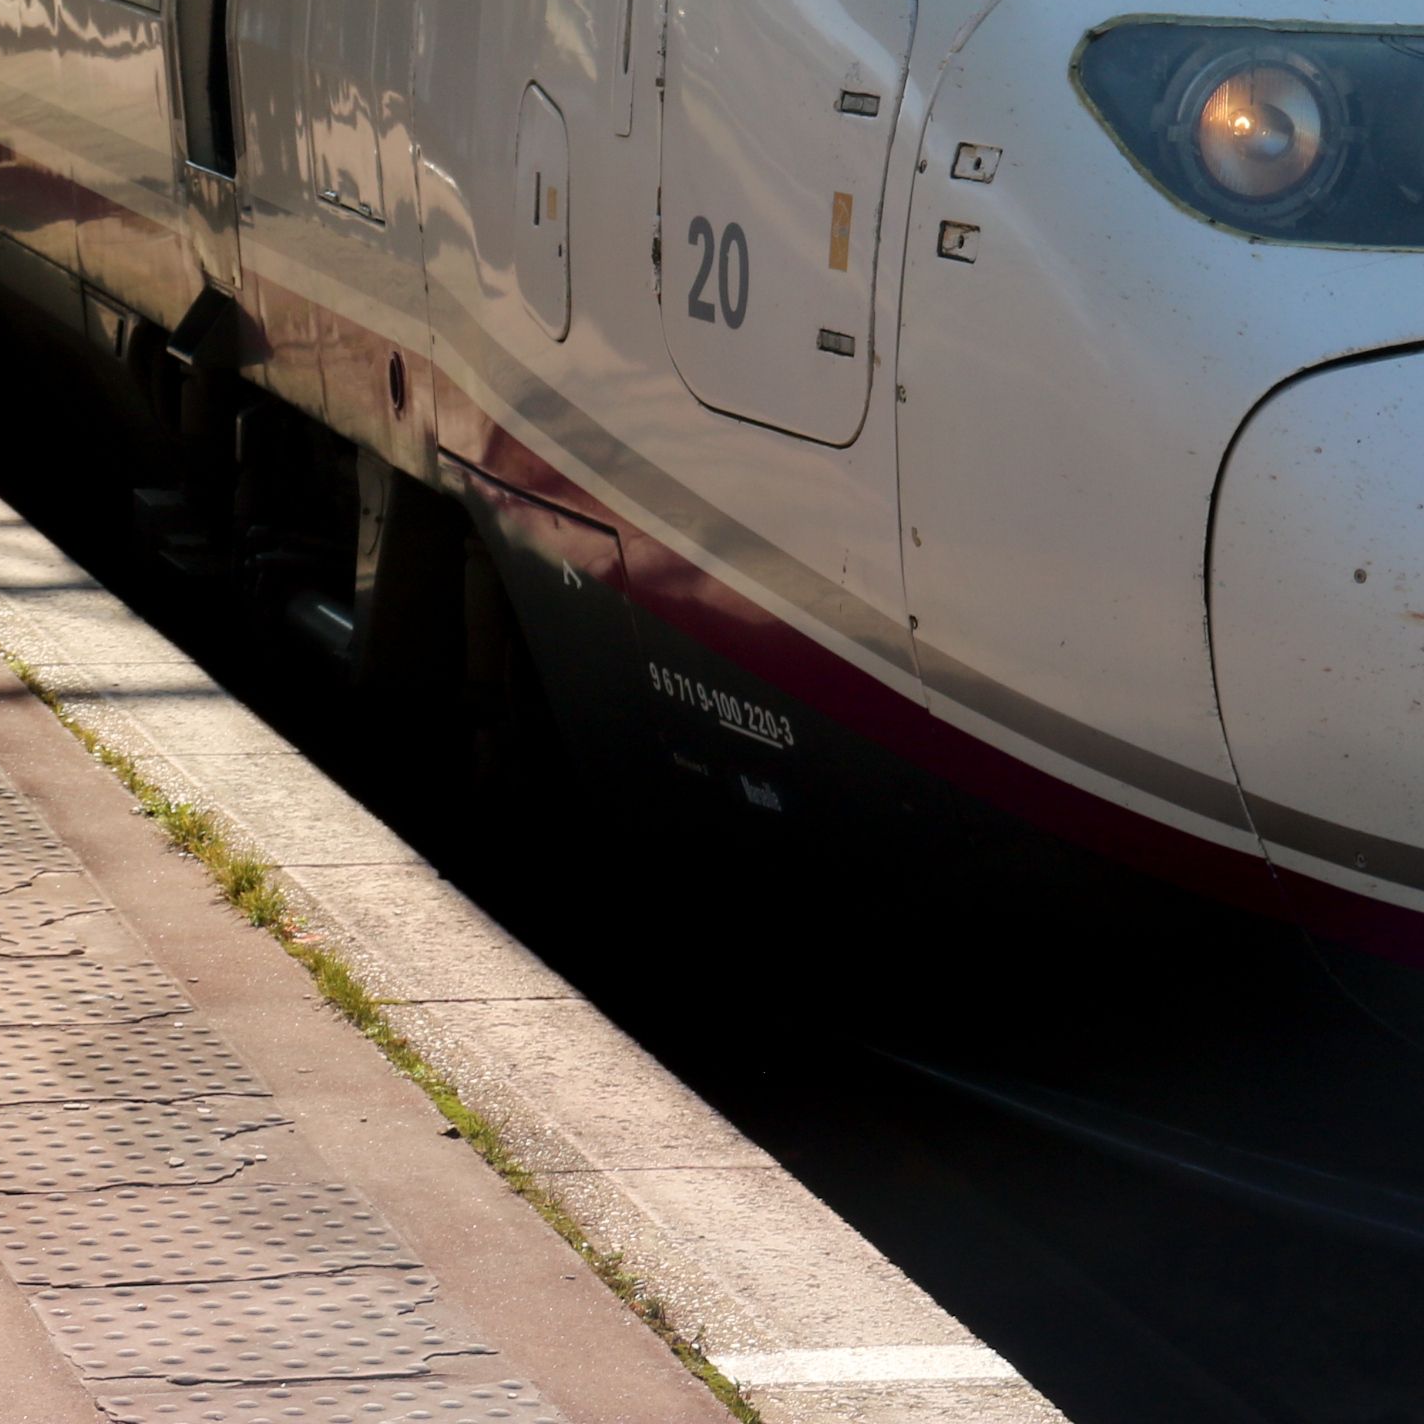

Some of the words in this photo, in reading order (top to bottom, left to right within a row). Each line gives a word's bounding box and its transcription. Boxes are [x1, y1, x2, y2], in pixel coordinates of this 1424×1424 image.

[687, 215, 749, 329] 20
[696, 682, 743, 726] 9-100
[744, 701, 795, 747] 220-3
